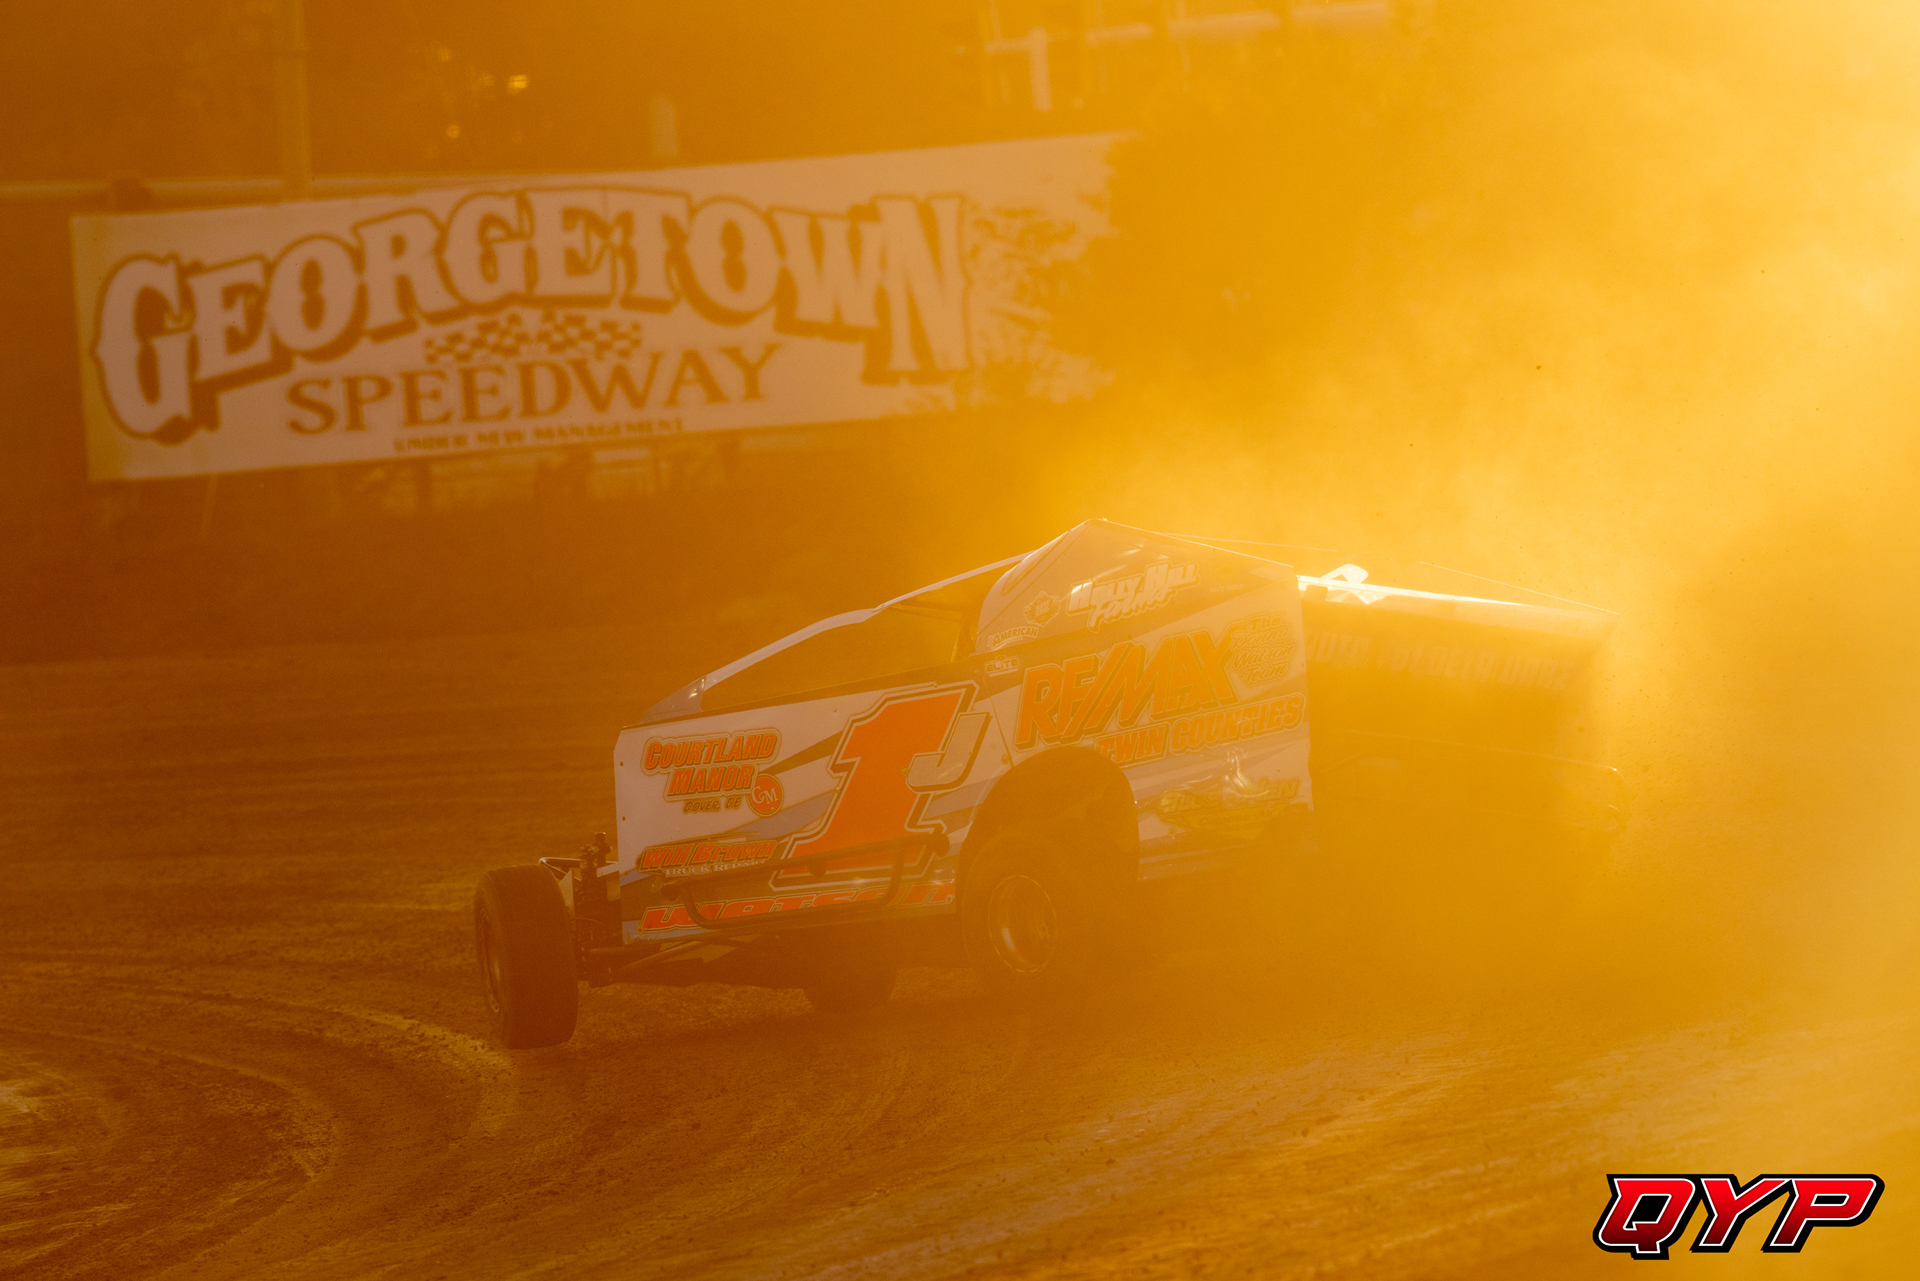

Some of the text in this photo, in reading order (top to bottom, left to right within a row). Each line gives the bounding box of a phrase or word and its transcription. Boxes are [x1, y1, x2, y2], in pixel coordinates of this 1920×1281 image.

[91, 186, 972, 445] GEORGETOWN
[287, 343, 783, 435] SPEEDWAY
[477, 429, 523, 446] NEW
[533, 416, 682, 442] MANAGEMENT
[993, 626, 1038, 647] AMERICAN
[1015, 621, 1244, 750] RE/MAX
[1171, 694, 1304, 754] COUNTIES
[644, 732, 777, 772] COURTLAND
[667, 764, 755, 797] MANOR
[642, 840, 777, 869] Will Brown
[664, 863, 711, 878] TRUCK
